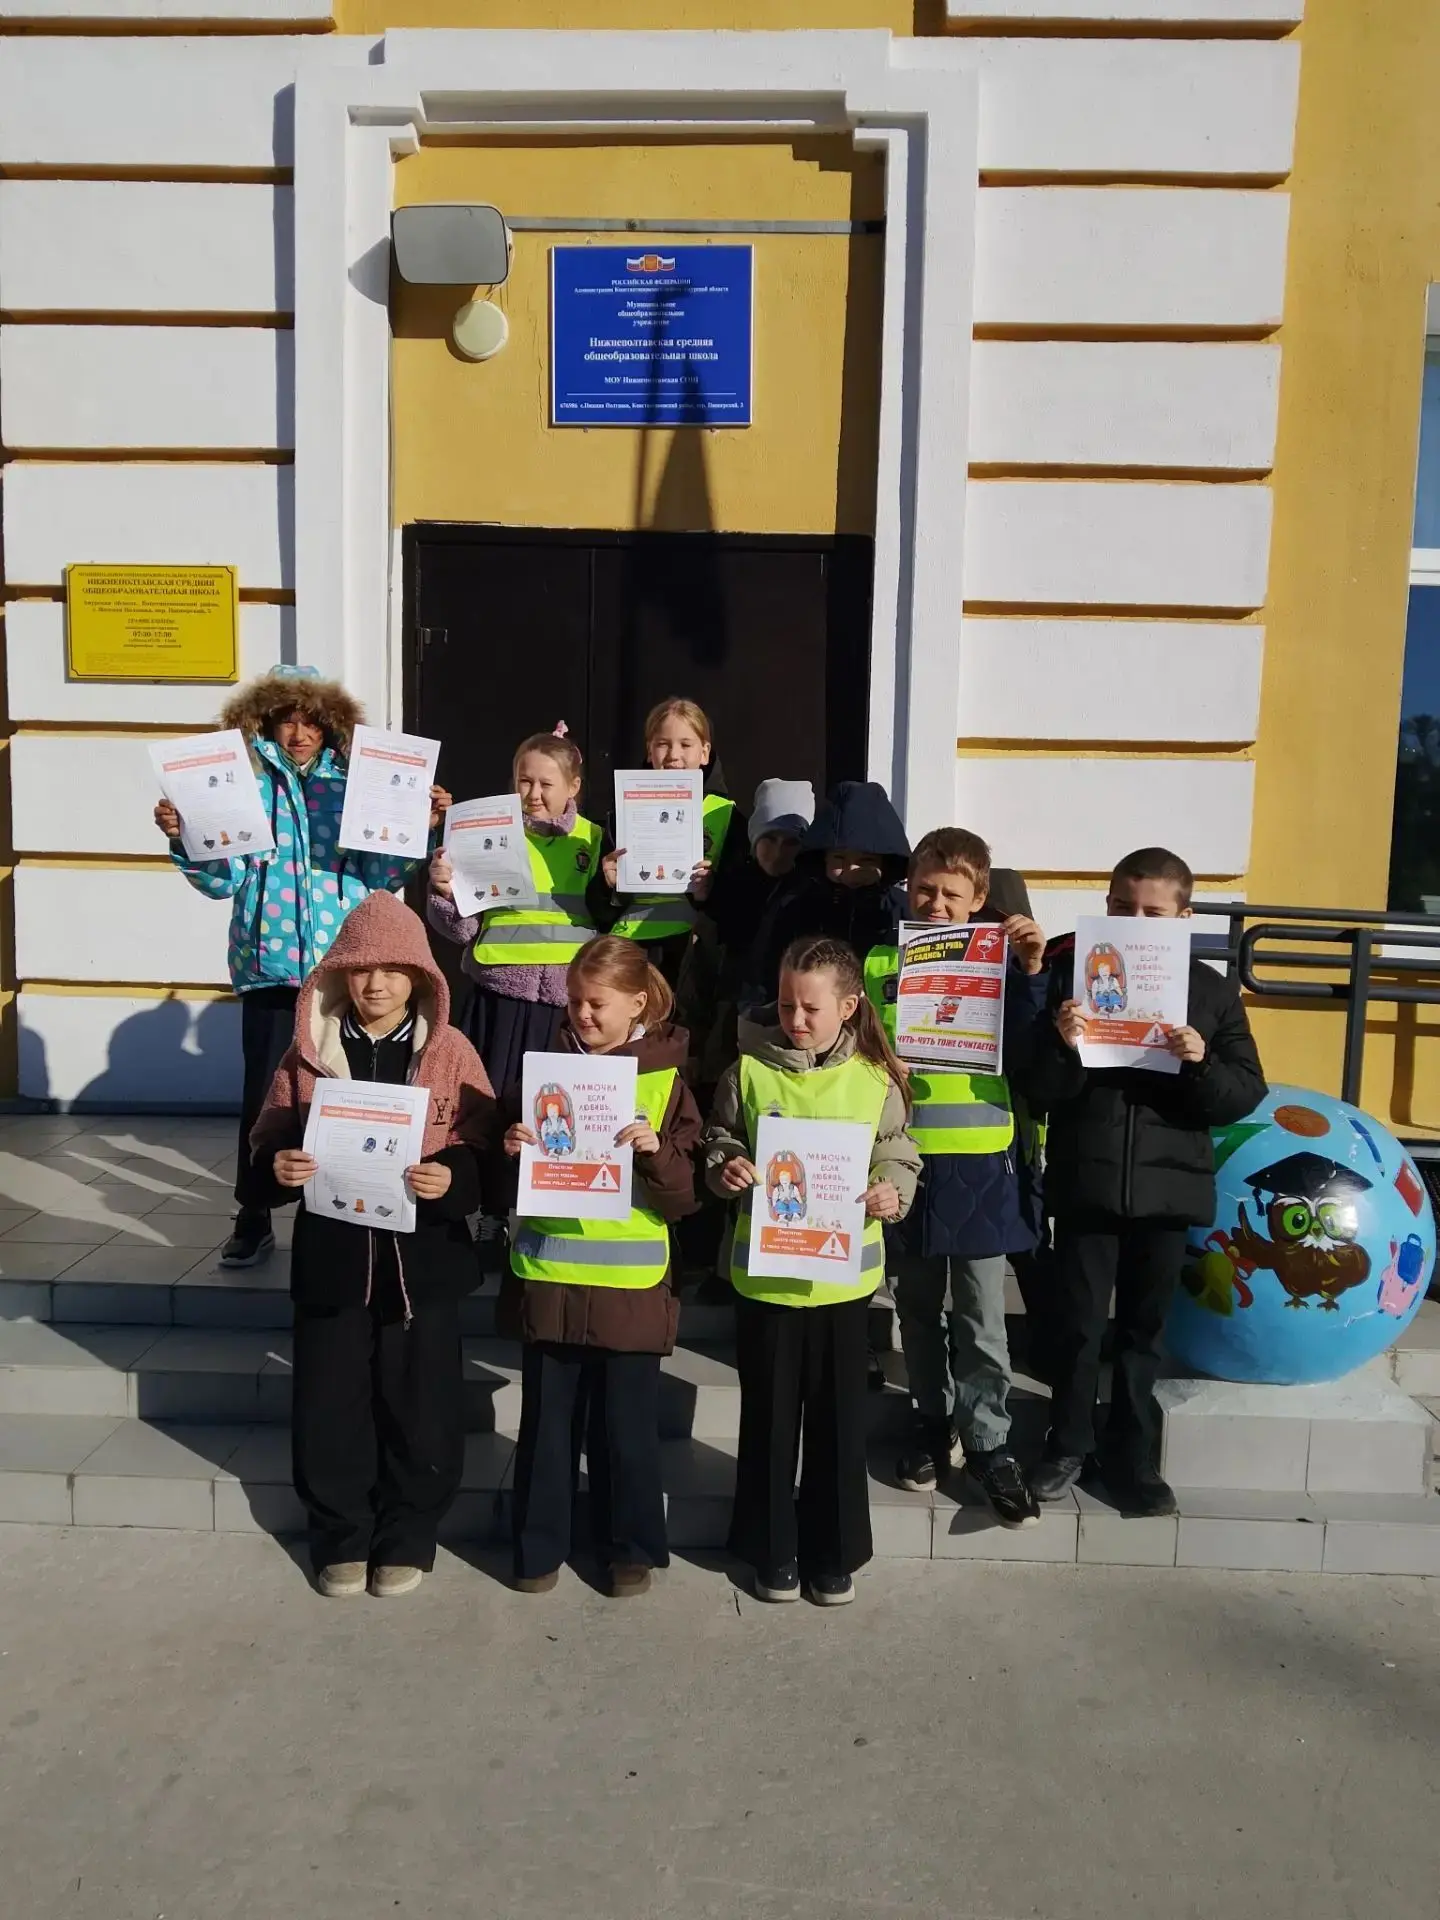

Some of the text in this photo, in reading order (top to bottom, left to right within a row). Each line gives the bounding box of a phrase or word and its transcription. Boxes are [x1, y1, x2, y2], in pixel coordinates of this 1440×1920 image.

[589, 337, 713, 348] Нижнеполтавская средняя
[584, 352, 718, 363] общеобразовательная школа
[604, 376, 622, 384] МОУ
[896, 1034, 936, 1046] ЧУТЬ-ЧУТЬ
[937, 1038, 956, 1048] ТОЖЕ
[572, 1083, 617, 1092] МАМОЧКА
[588, 1094, 606, 1102] ЕСЛИ
[806, 1152, 852, 1163] МАМОЧКА
